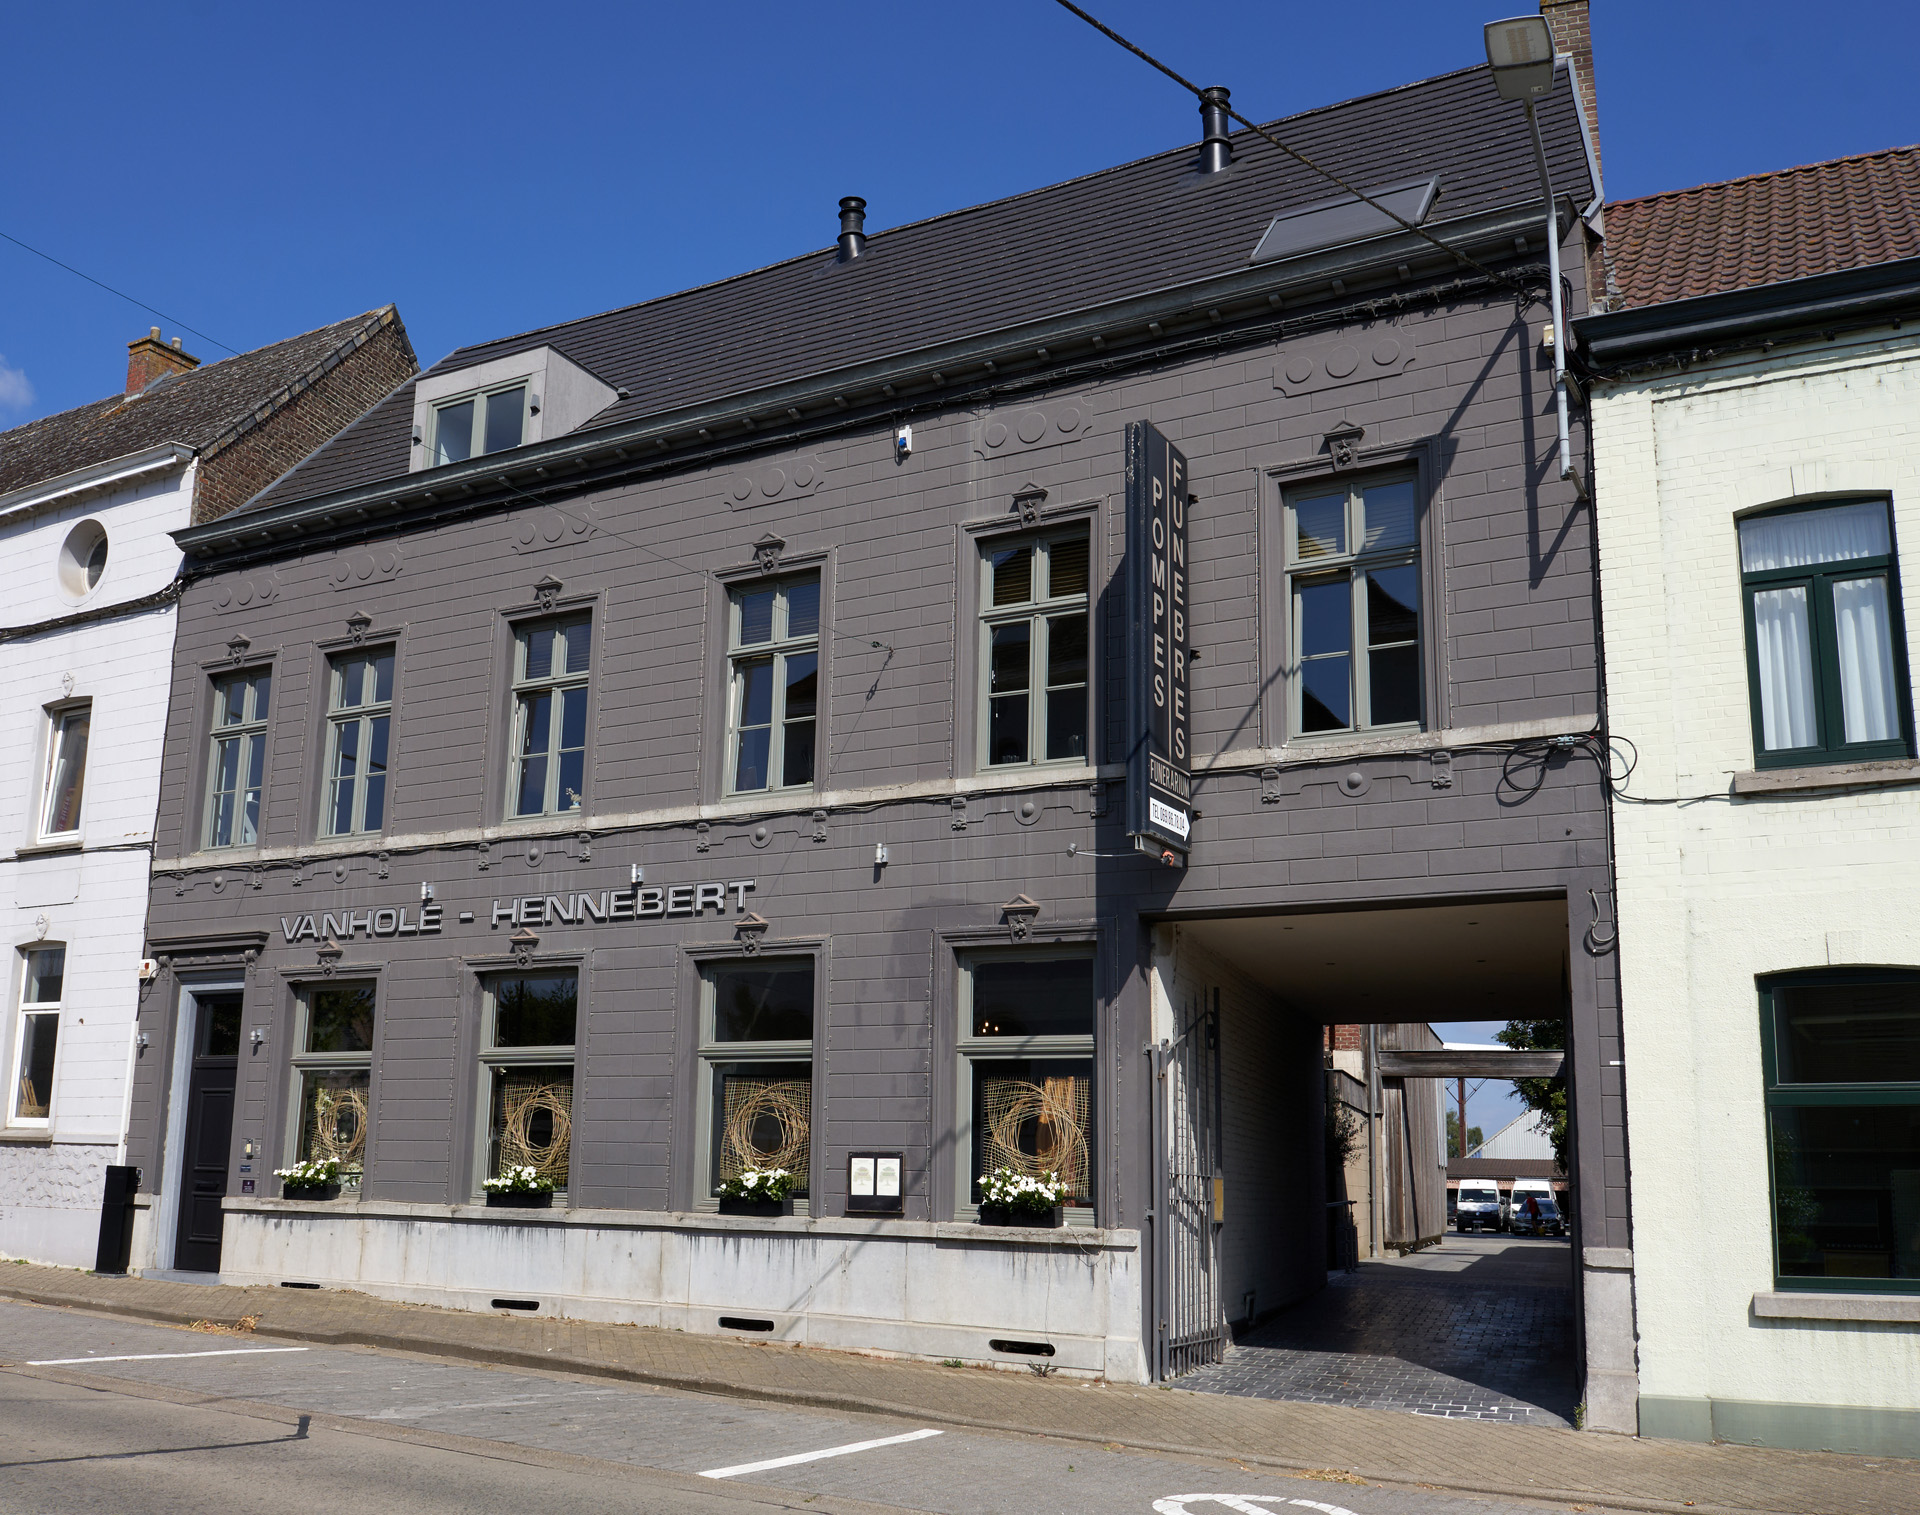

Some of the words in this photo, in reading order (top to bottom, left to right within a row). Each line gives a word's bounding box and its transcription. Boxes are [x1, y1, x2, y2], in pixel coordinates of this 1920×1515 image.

[1152, 475, 1166, 708] POMPES
[1172, 457, 1185, 761] FUNEBRES
[1150, 758, 1190, 800] FUNERARIUM
[281, 904, 442, 943] VANHOLE
[491, 879, 757, 930] HENNEBERT
